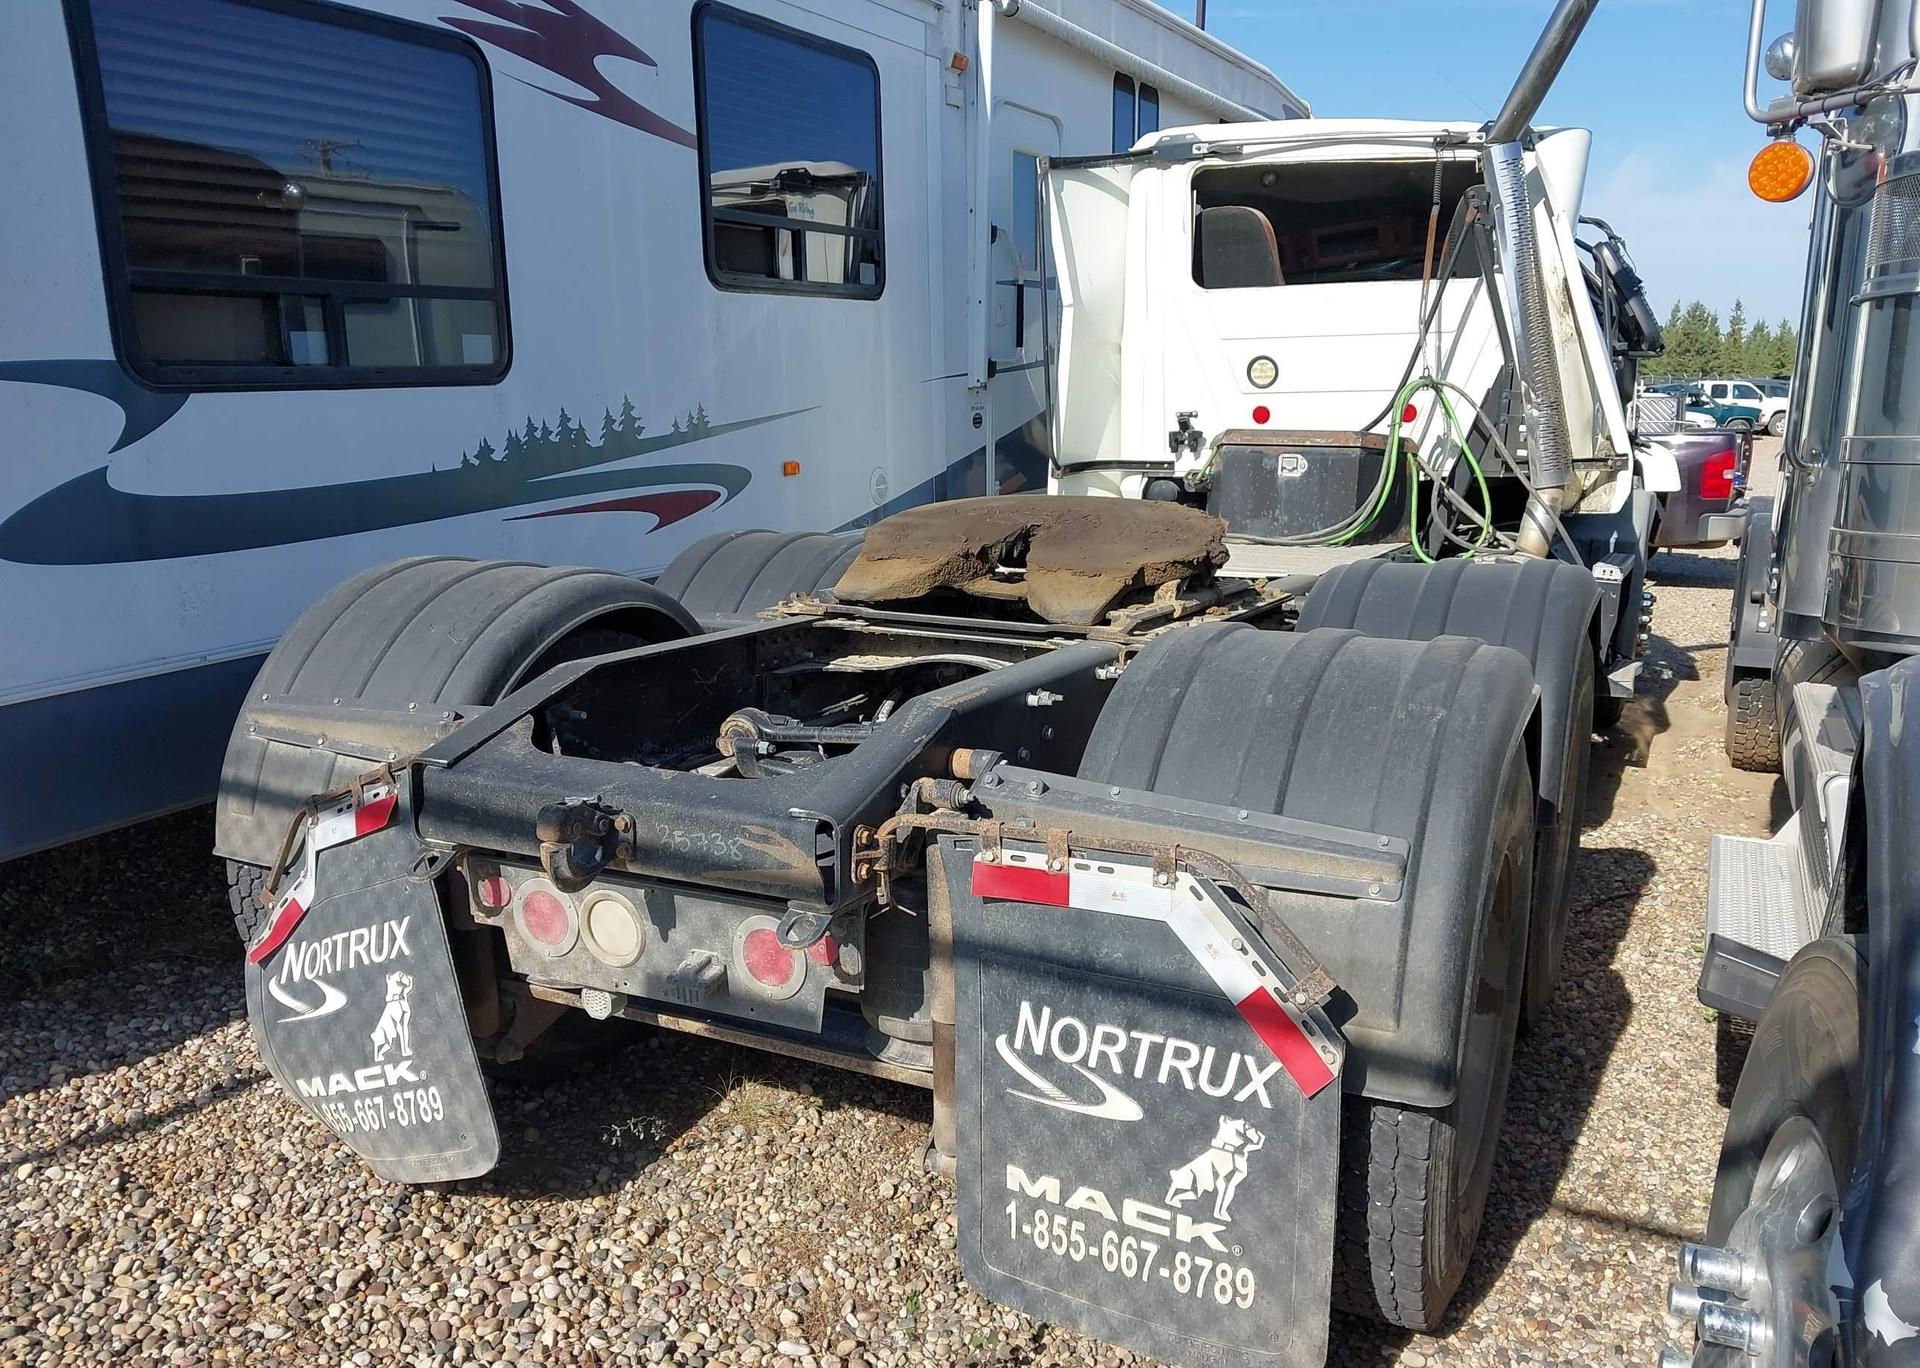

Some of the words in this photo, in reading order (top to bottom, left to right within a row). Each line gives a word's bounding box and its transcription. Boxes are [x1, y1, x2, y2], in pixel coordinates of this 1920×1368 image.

[280, 916, 412, 985] NORTRUX
[296, 1060, 420, 1099] MACK
[1013, 1000, 1283, 1109] NORTRUX
[1005, 1164, 1229, 1254] MACK
[1004, 1200, 1256, 1309] 1-855-667-8789
